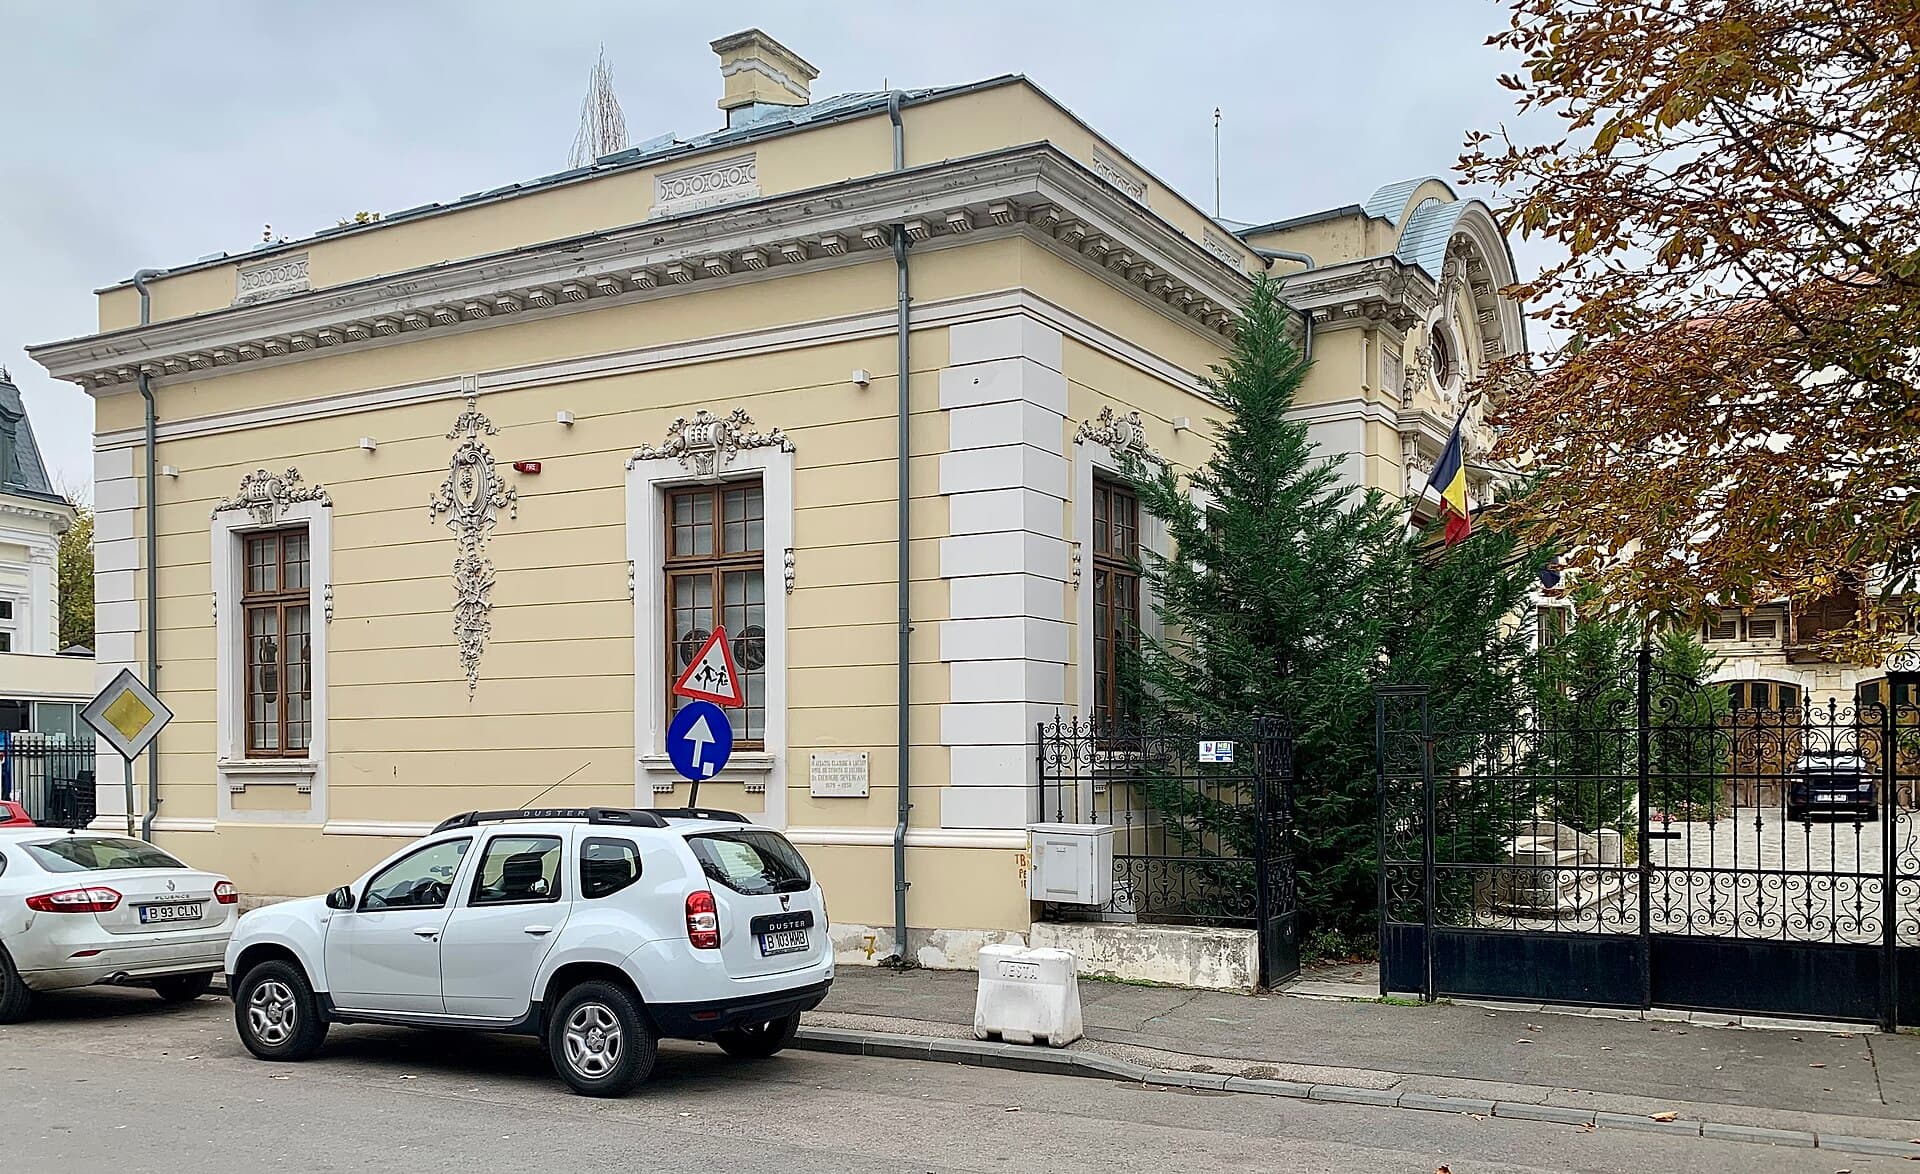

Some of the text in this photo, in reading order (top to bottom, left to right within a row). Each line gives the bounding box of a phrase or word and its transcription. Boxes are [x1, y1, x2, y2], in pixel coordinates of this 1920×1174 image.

[150, 905, 198, 919] B 93 CLN
[769, 920, 806, 931] DUSTER
[767, 934, 775, 949] B
